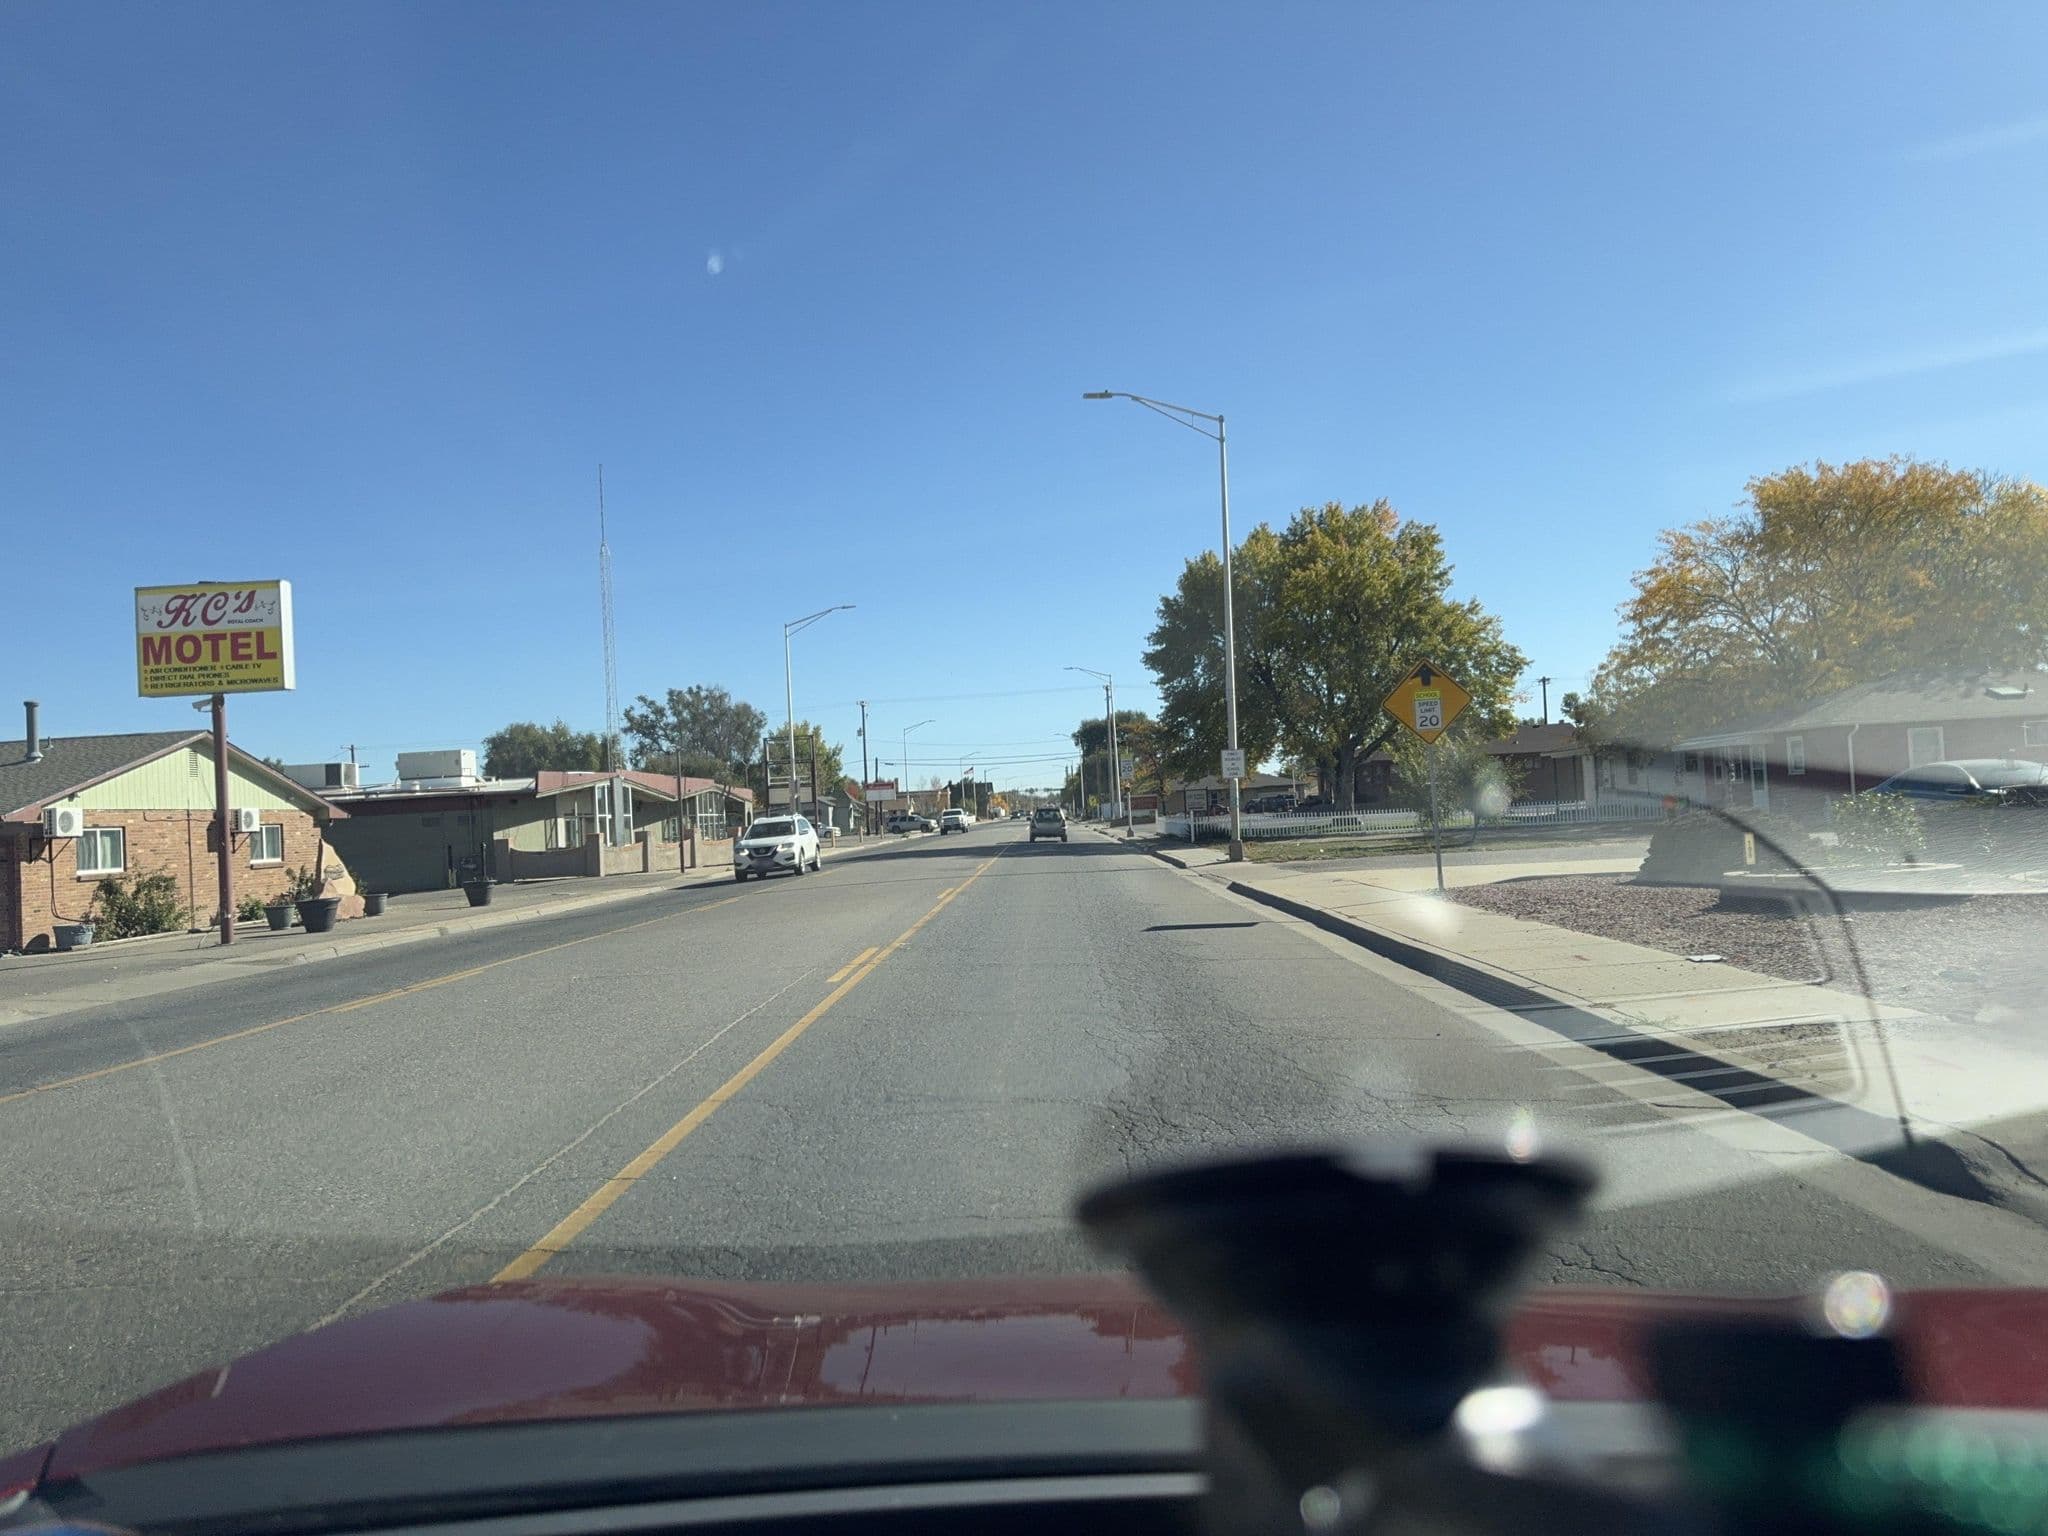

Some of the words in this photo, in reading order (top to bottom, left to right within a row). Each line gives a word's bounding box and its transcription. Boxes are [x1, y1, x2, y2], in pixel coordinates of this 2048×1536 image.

[142, 631, 277, 666] MOTEL
[164, 665, 216, 673] CONDITIONER
[197, 672, 230, 680] PHONES
[150, 680, 215, 689] REFRIGERATORS
[226, 677, 278, 685] MICROWAVES
[1419, 715, 1439, 727] 20
